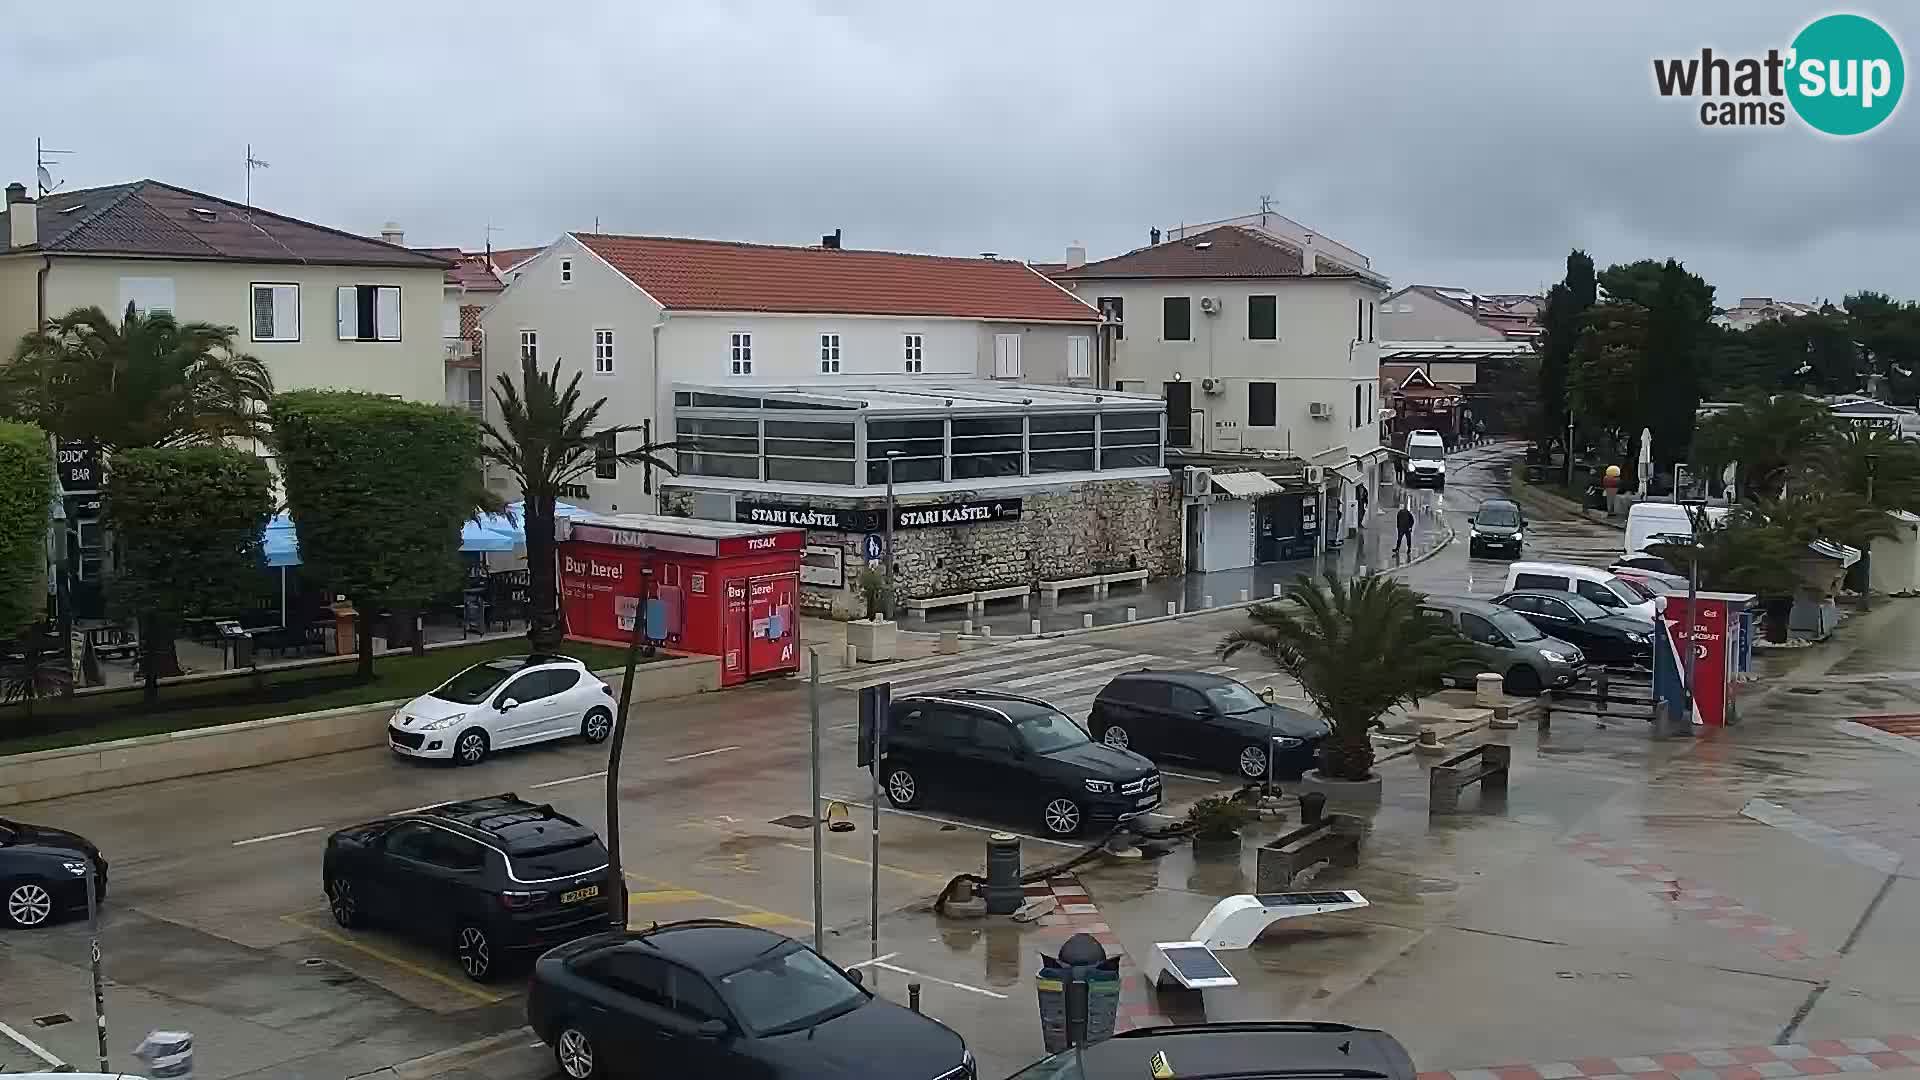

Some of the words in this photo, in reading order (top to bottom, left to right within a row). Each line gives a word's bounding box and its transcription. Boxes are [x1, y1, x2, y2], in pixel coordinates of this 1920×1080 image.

[72, 468, 90, 481] BAR
[751, 508, 787, 524] STARI
[789, 509, 839, 528] KAŠTEL
[900, 511, 939, 526] STARI
[942, 504, 991, 522] KAŠTEL
[611, 531, 648, 548] TISAK
[748, 537, 776, 549] TISAK
[565, 556, 587, 577] Buy
[591, 560, 623, 580] here!
[728, 586, 746, 599] Buy
[751, 581, 774, 596] here!
[781, 643, 793, 661] A1
